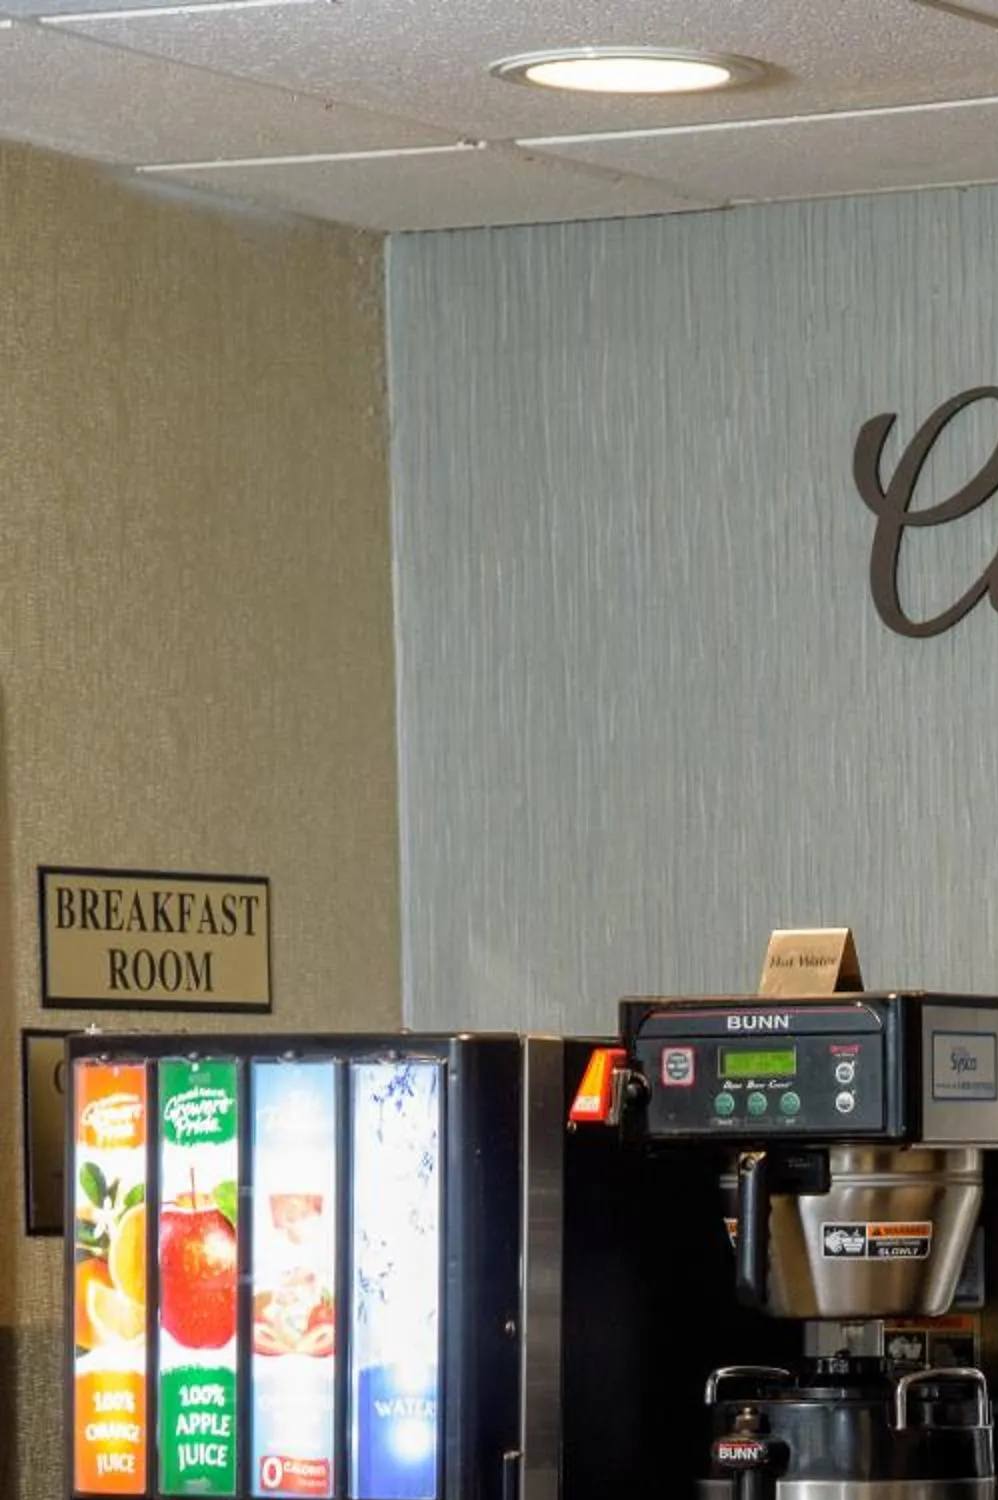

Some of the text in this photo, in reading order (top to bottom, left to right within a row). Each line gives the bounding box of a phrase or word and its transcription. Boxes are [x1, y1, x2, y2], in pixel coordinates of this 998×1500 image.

[56, 887, 260, 936] BREAKFAST
[108, 948, 214, 993] ROOM
[726, 1014, 790, 1030] BUNN
[178, 1384, 226, 1407] 100%
[175, 1412, 232, 1438] APPLE
[96, 1453, 136, 1476] JUICE
[177, 1443, 229, 1473] JUICE
[718, 1447, 759, 1460] BUNN
[262, 1456, 284, 1489] 0
